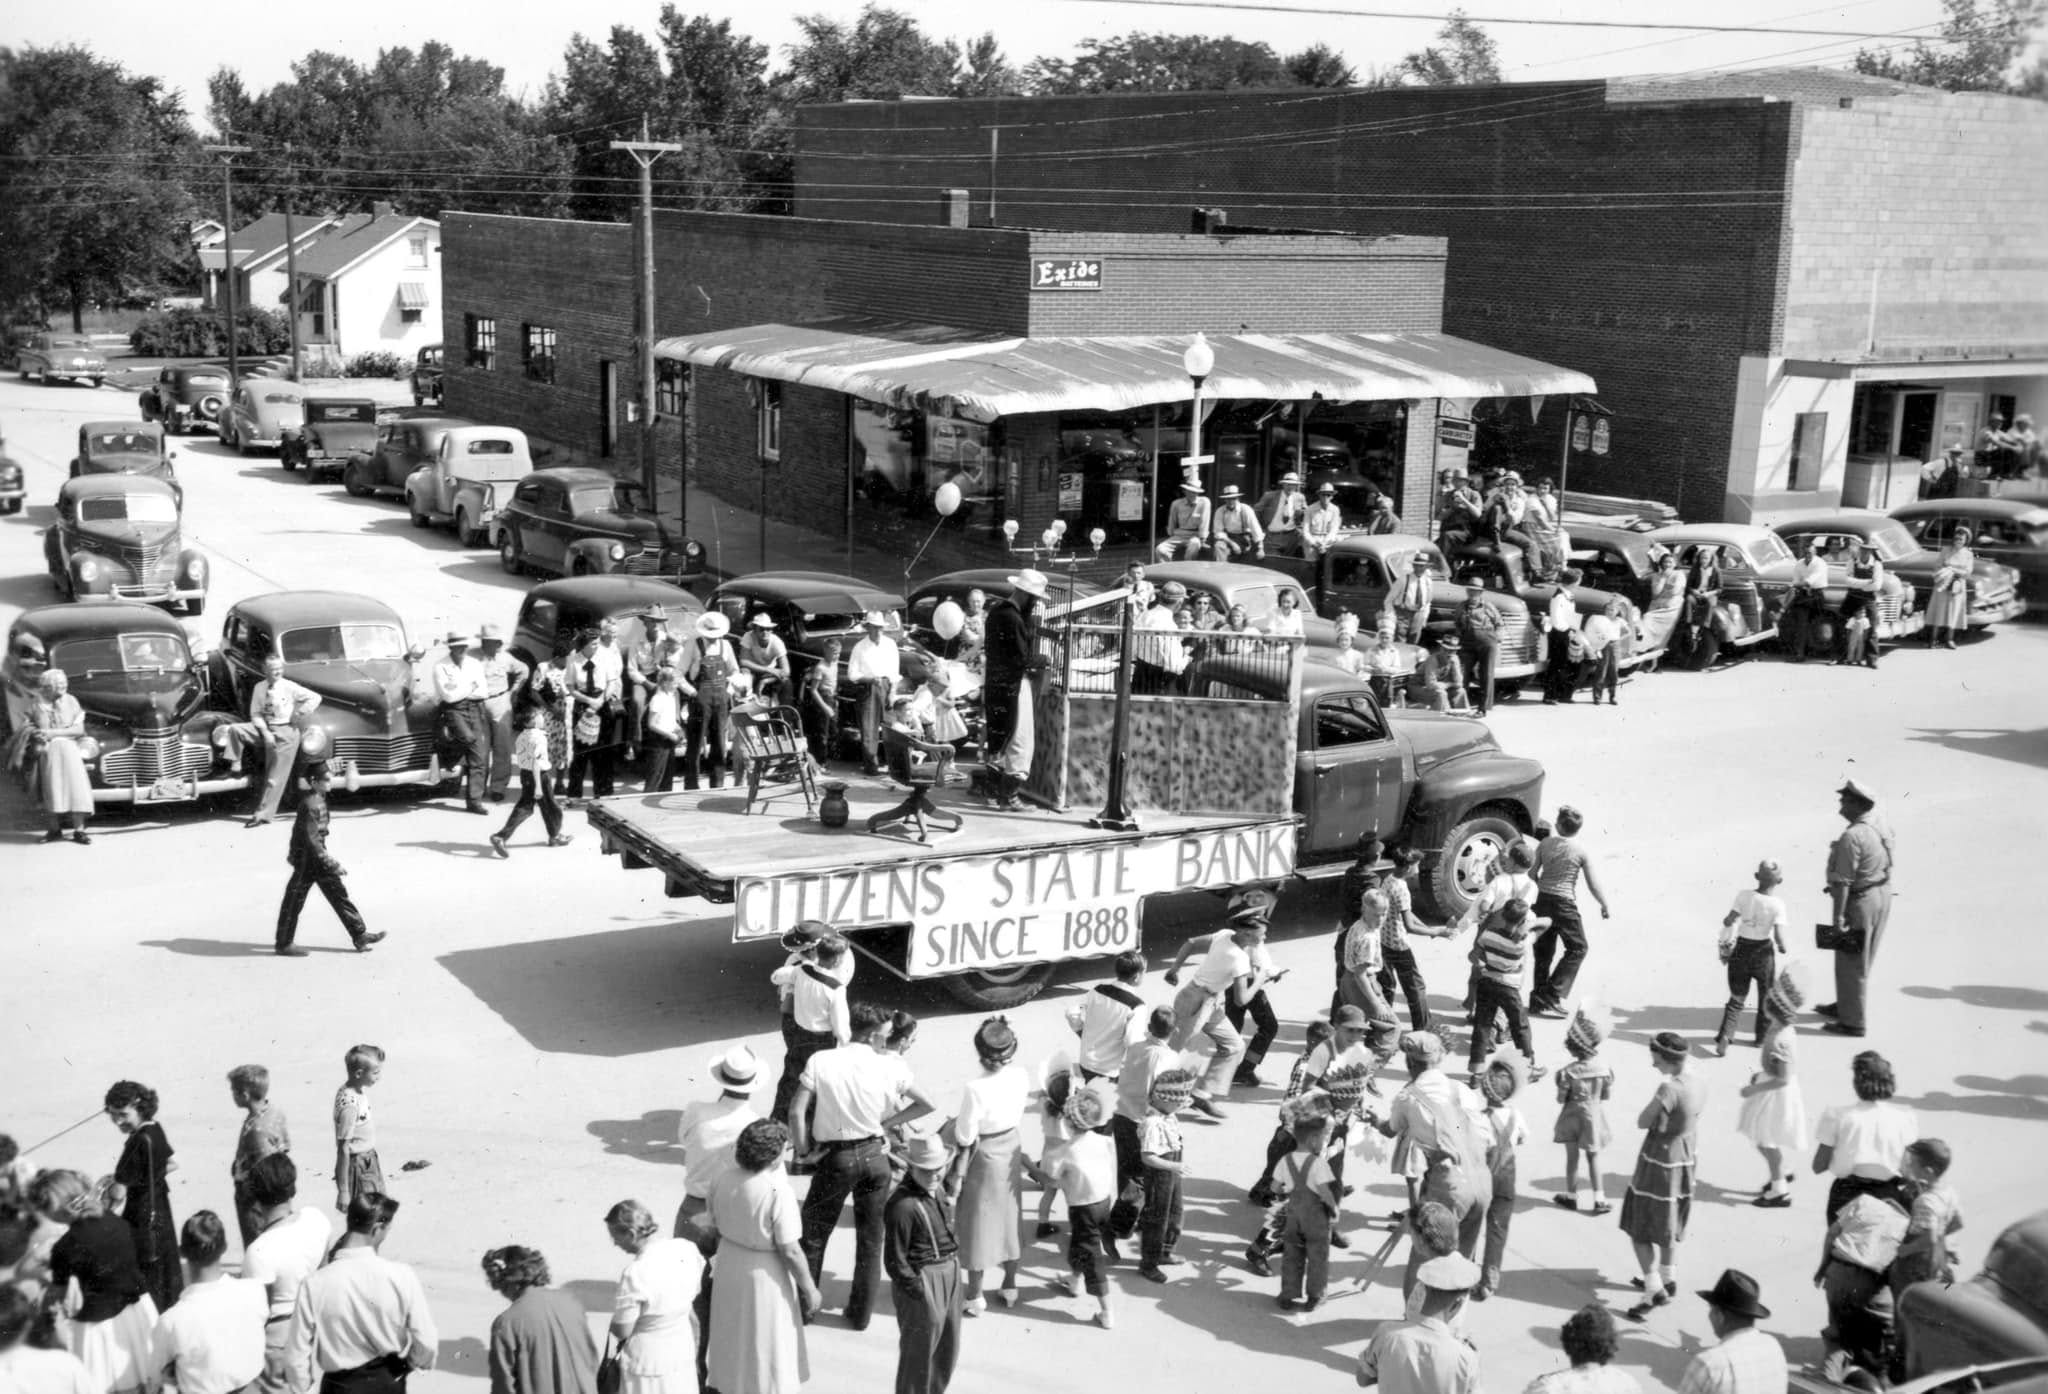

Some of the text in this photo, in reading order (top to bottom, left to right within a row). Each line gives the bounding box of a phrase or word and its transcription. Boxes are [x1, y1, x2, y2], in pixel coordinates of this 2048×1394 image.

[1037, 261, 1098, 285] Exide
[737, 828, 1292, 933] CITIZENS STATE BANK
[926, 906, 1129, 968] SINCE 1888
